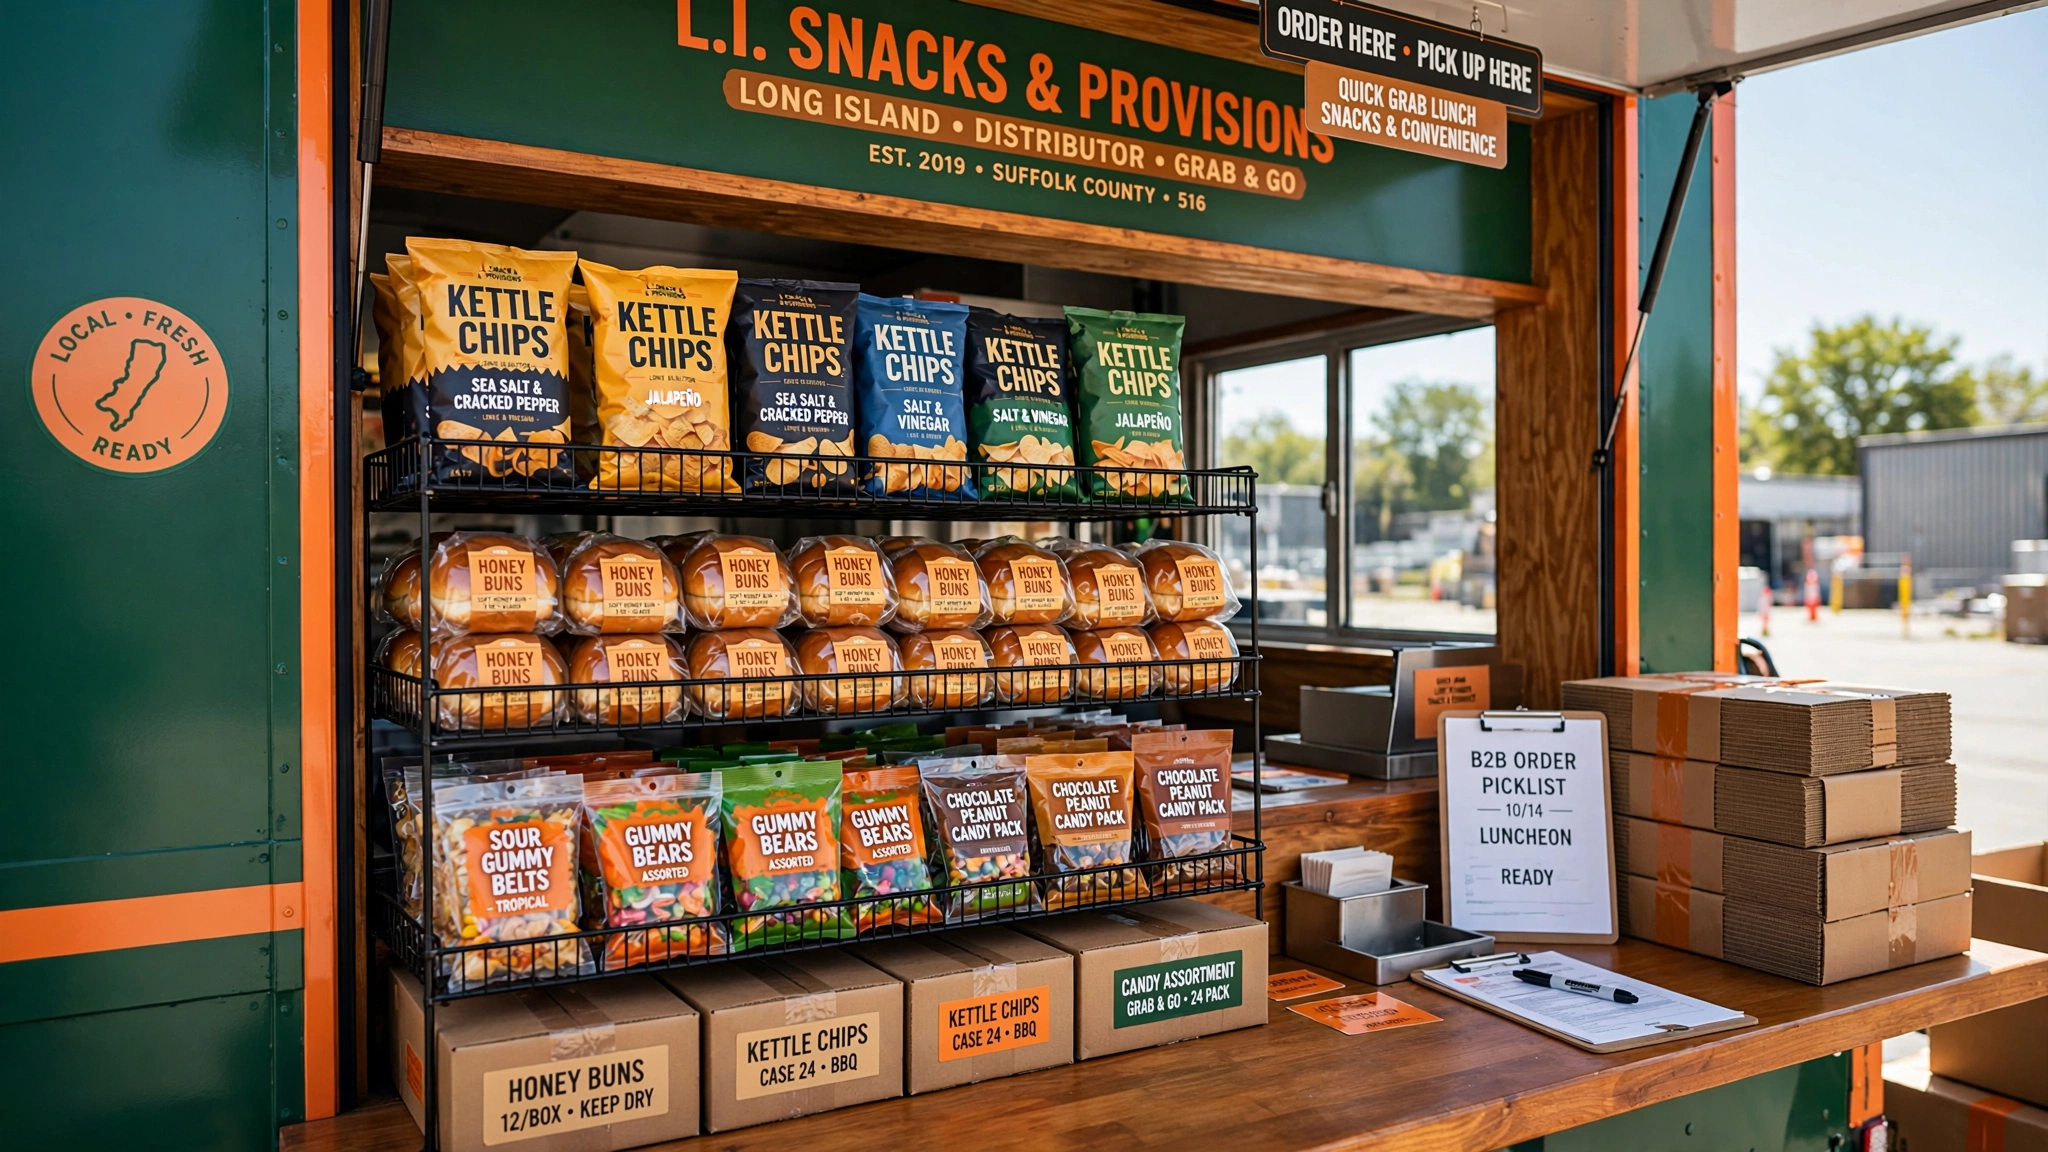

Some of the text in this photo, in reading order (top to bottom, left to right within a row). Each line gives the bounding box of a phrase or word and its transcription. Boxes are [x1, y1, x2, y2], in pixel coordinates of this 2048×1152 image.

[677, 0, 766, 61] L.I.
[788, 6, 1008, 104] SNACKS
[1025, 52, 1063, 114] &
[1278, 6, 1532, 94] ORDER HERE PICK UP HERE
[1338, 76, 1476, 127] QUICK GRAB LUNCH
[739, 77, 1297, 194] LONG ISLAND DISTRIBUTOR GRAB & GO
[1321, 101, 1497, 158] SNACKS & CONVENIENCE
[869, 144, 1206, 212] EST. 2019 SUFFOLK COUNTY 516
[448, 284, 555, 323] KETTLE
[617, 301, 717, 338] KETTLE
[753, 310, 845, 345] KETTLE
[50, 310, 209, 366] LOCAL FRESH
[458, 321, 549, 359] CHIPS
[874, 323, 956, 357] KETTLE
[628, 335, 713, 372] CHIPS
[764, 342, 841, 377] CHIPS
[984, 337, 1061, 370] KETTLE
[1096, 341, 1174, 371] KETTLE
[885, 352, 955, 385] CHIPS
[471, 377, 543, 395] SEA SALT &
[996, 365, 1061, 397] CHIPS
[1107, 368, 1172, 399] CHIPS
[454, 394, 560, 414] CRACKED PEPPER
[645, 387, 702, 408] JALAPEÑO
[775, 391, 836, 408] SEA SALT &
[760, 407, 849, 426] CRACKED PEPPER
[903, 399, 943, 416] SALT &
[992, 408, 1019, 423] SALT
[1021, 408, 1031, 423] &
[897, 414, 950, 433] VINEGAR
[1115, 411, 1172, 431] JALAPEÑO
[91, 436, 172, 461] READY
[478, 559, 525, 574] HONEY
[609, 566, 654, 580] HONEY
[729, 559, 770, 573] HONEY
[833, 557, 872, 571] HONEY
[1018, 566, 1053, 579] HONEY
[1184, 565, 1216, 579] HONEY
[484, 575, 523, 591] BUNS
[735, 574, 769, 588] BUNS
[840, 572, 871, 586] BUNS
[934, 567, 970, 581] HONEY
[1102, 574, 1136, 587] HONEY
[615, 582, 652, 597] BUNS
[939, 582, 969, 596] BUNS
[1024, 580, 1053, 593] BUNS
[1108, 588, 1135, 601] BUNS
[1190, 580, 1216, 593] BUNS
[1028, 642, 1062, 655] HONEY
[1110, 643, 1143, 656] HONEY
[1193, 637, 1224, 650] HONEY
[486, 651, 534, 668] HONEY
[616, 652, 660, 667] HONEY
[736, 651, 777, 666] HONEY
[842, 648, 881, 662] HONEY
[941, 647, 976, 660] HONEY
[492, 668, 531, 685] BUNS
[621, 668, 658, 683] BUNS
[742, 666, 775, 678] BUNS
[1471, 751, 1577, 770] B2B ORDER
[1157, 768, 1220, 786] CHOCOLATE
[1482, 776, 1567, 796] PICKLIST
[1052, 779, 1119, 798] CHOCOLATE
[1169, 784, 1213, 801] PEANUT
[946, 788, 1015, 809] CHOCOLATE
[1065, 795, 1111, 812] PEANUT
[851, 805, 909, 828] GUMMY
[960, 805, 1008, 824] PEANUT
[1159, 799, 1226, 818] CANDY PACK
[1505, 803, 1543, 819] 10/14
[751, 810, 817, 835] GUMMY
[1055, 809, 1126, 829] CANDY PACK
[489, 827, 542, 851] SOUR
[625, 821, 693, 846] GUMMY
[859, 822, 913, 847] BEARS
[951, 820, 1024, 842] CANDY PACK
[1480, 827, 1572, 846] LUNCHEON
[760, 831, 818, 855] BEARS
[481, 846, 554, 874] GUMMY
[632, 841, 694, 868] BEARS
[768, 855, 814, 871] ASSORTED
[491, 868, 550, 896] BELTS
[641, 866, 689, 882] ASSORTED
[1501, 868, 1554, 886] READY
[495, 895, 549, 913] TROPICAL
[1121, 961, 1236, 997] CANDY ASSORTMENT
[1127, 984, 1230, 1017] GRAB & GO 24 PACK
[948, 995, 1040, 1029] KETTLE CHIPS
[747, 1022, 869, 1064] KETTLE CHIPS
[952, 1020, 1037, 1051] CASE 24 BBQ
[760, 1052, 858, 1087] CASE 24 BBQ
[509, 1058, 645, 1104] HONEY BUNS
[500, 1087, 655, 1133] 12/BOX KEEP DRY
